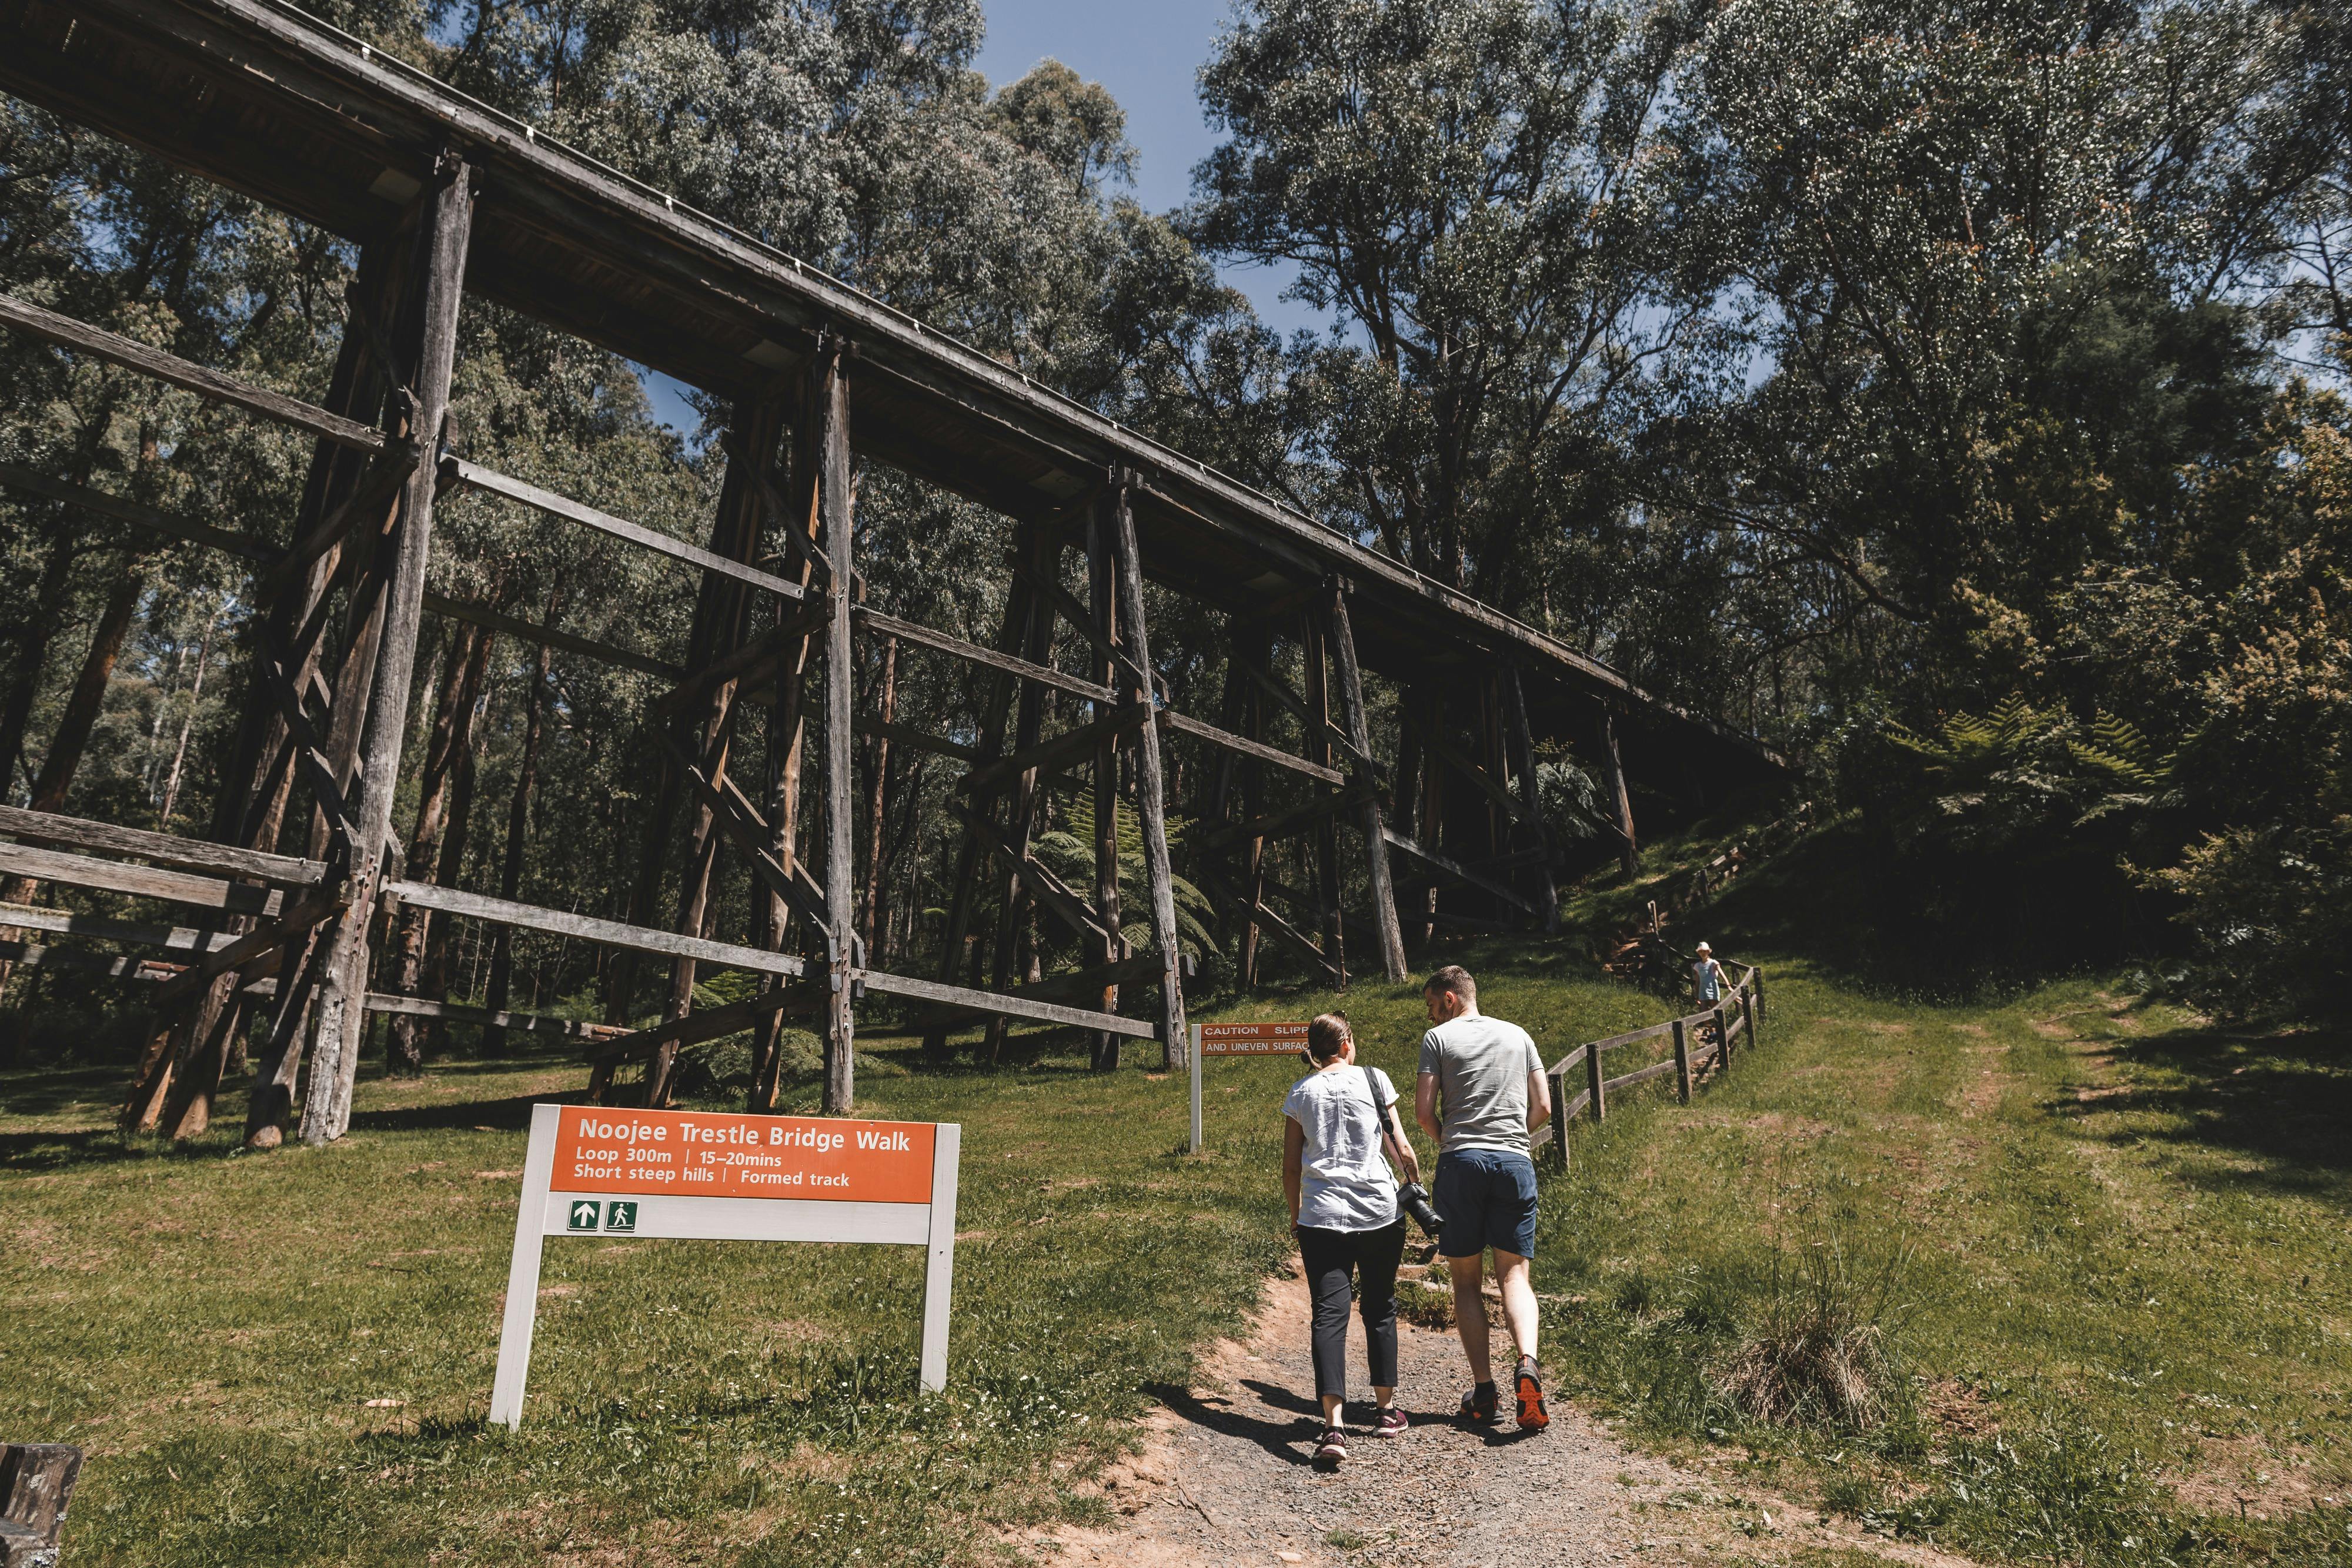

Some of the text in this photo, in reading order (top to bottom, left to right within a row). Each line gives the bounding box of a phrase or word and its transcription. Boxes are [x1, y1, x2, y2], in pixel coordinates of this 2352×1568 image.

[1205, 1027, 1258, 1035] CAUTION
[1206, 1042, 1308, 1051] AND UNEVEN SURFAC
[579, 1118, 910, 1153] Noojee Trestle Bridge Walk
[576, 1146, 619, 1164] Loop
[626, 1148, 671, 1163] 300m
[574, 1164, 850, 1187] Short steep hills Formed track
